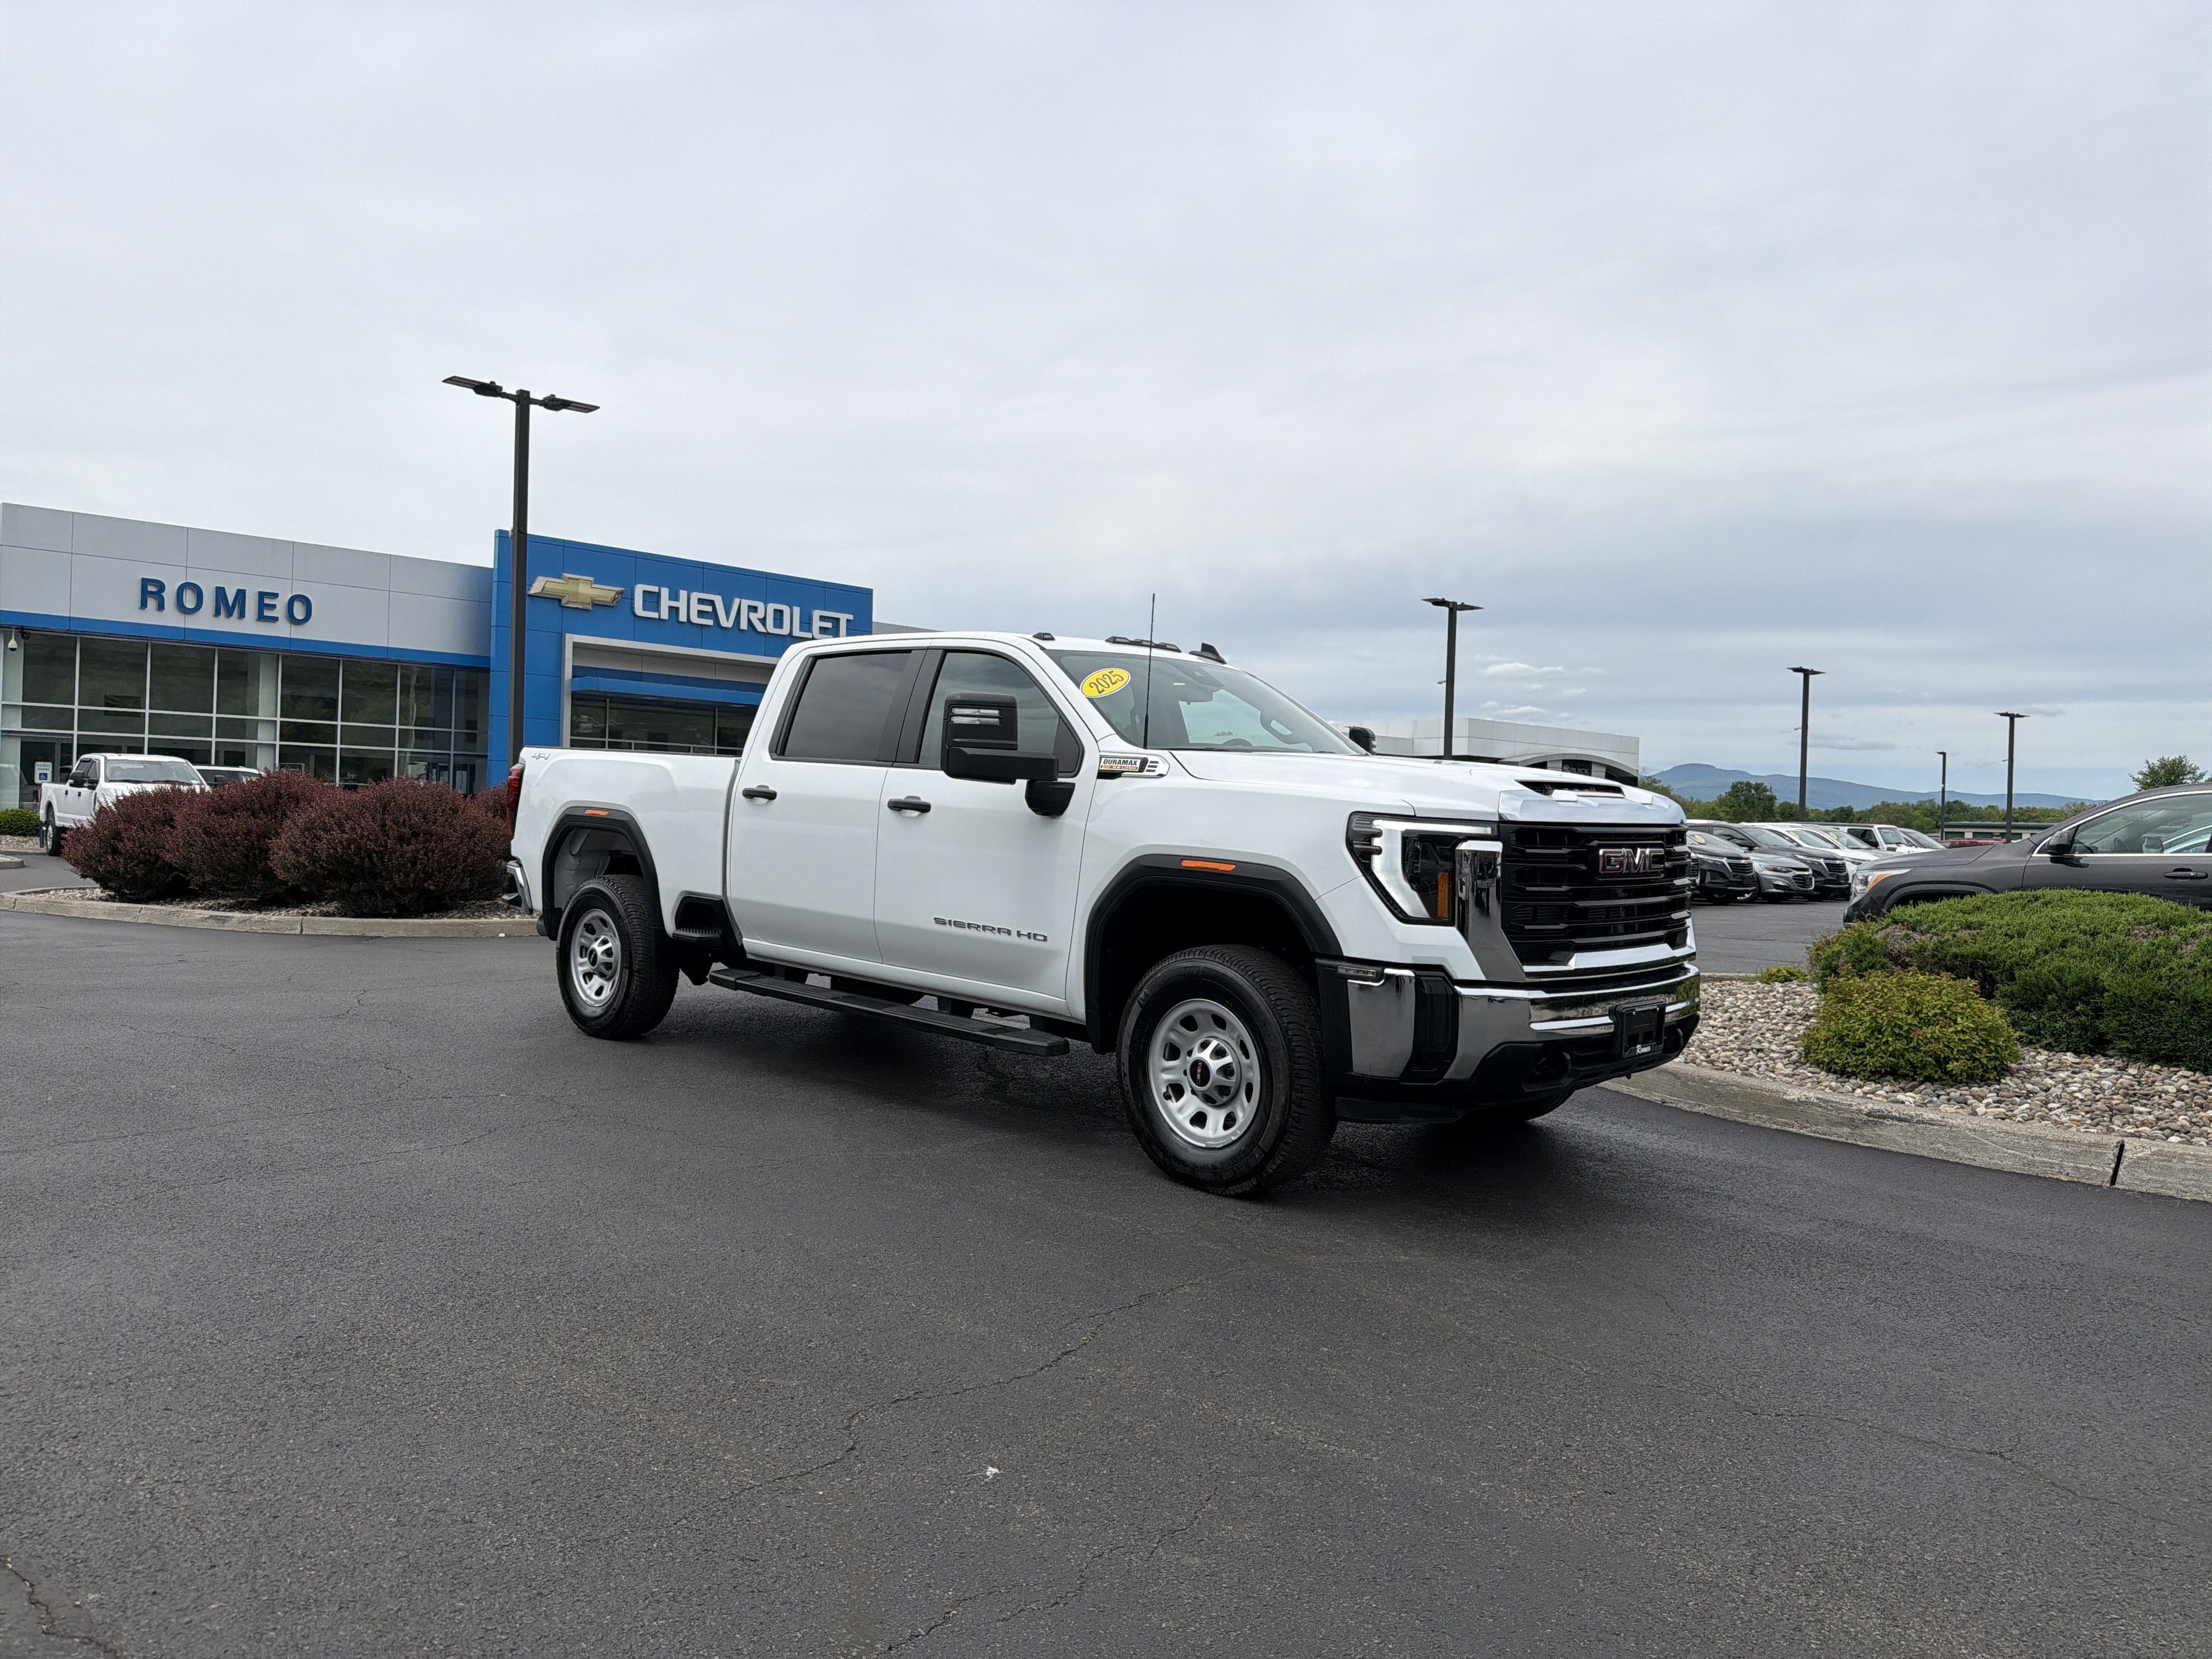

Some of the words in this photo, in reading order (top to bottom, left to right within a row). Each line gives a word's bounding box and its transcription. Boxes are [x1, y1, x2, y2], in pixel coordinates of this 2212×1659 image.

[139, 578, 312, 625] ROMEO
[634, 584, 854, 640] CHEVROLET
[1089, 670, 1124, 694] 2025
[1599, 848, 1664, 874] GMC
[934, 917, 1011, 936] SIERRA
[1017, 930, 1048, 942] HD
